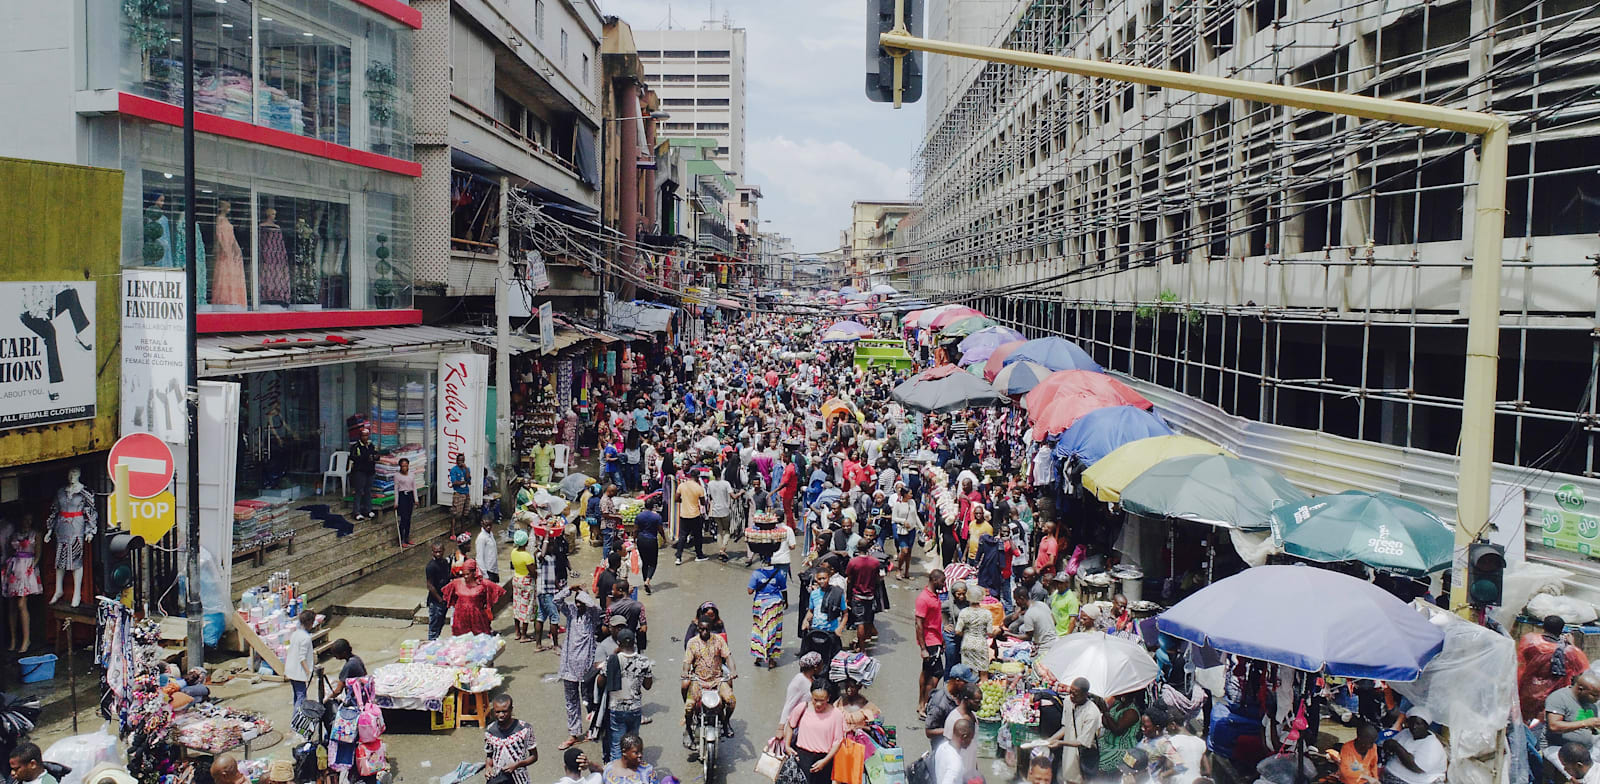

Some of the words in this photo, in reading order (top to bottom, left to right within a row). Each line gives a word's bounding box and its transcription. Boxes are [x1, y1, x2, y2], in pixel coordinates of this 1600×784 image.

[127, 280, 182, 299] LENCARL
[126, 300, 184, 320] FASHIONS
[134, 345, 173, 353] WHOLESALE
[4, 390, 26, 399] ABOUT
[18, 410, 49, 420] FEMALE
[50, 406, 86, 417] CLOTHING
[1558, 490, 1580, 505] glo
[129, 501, 169, 519] TOP
[1543, 513, 1558, 529] glo
[1578, 518, 1596, 535] glo
[1368, 538, 1403, 548] green
[1374, 545, 1404, 556] lotto
